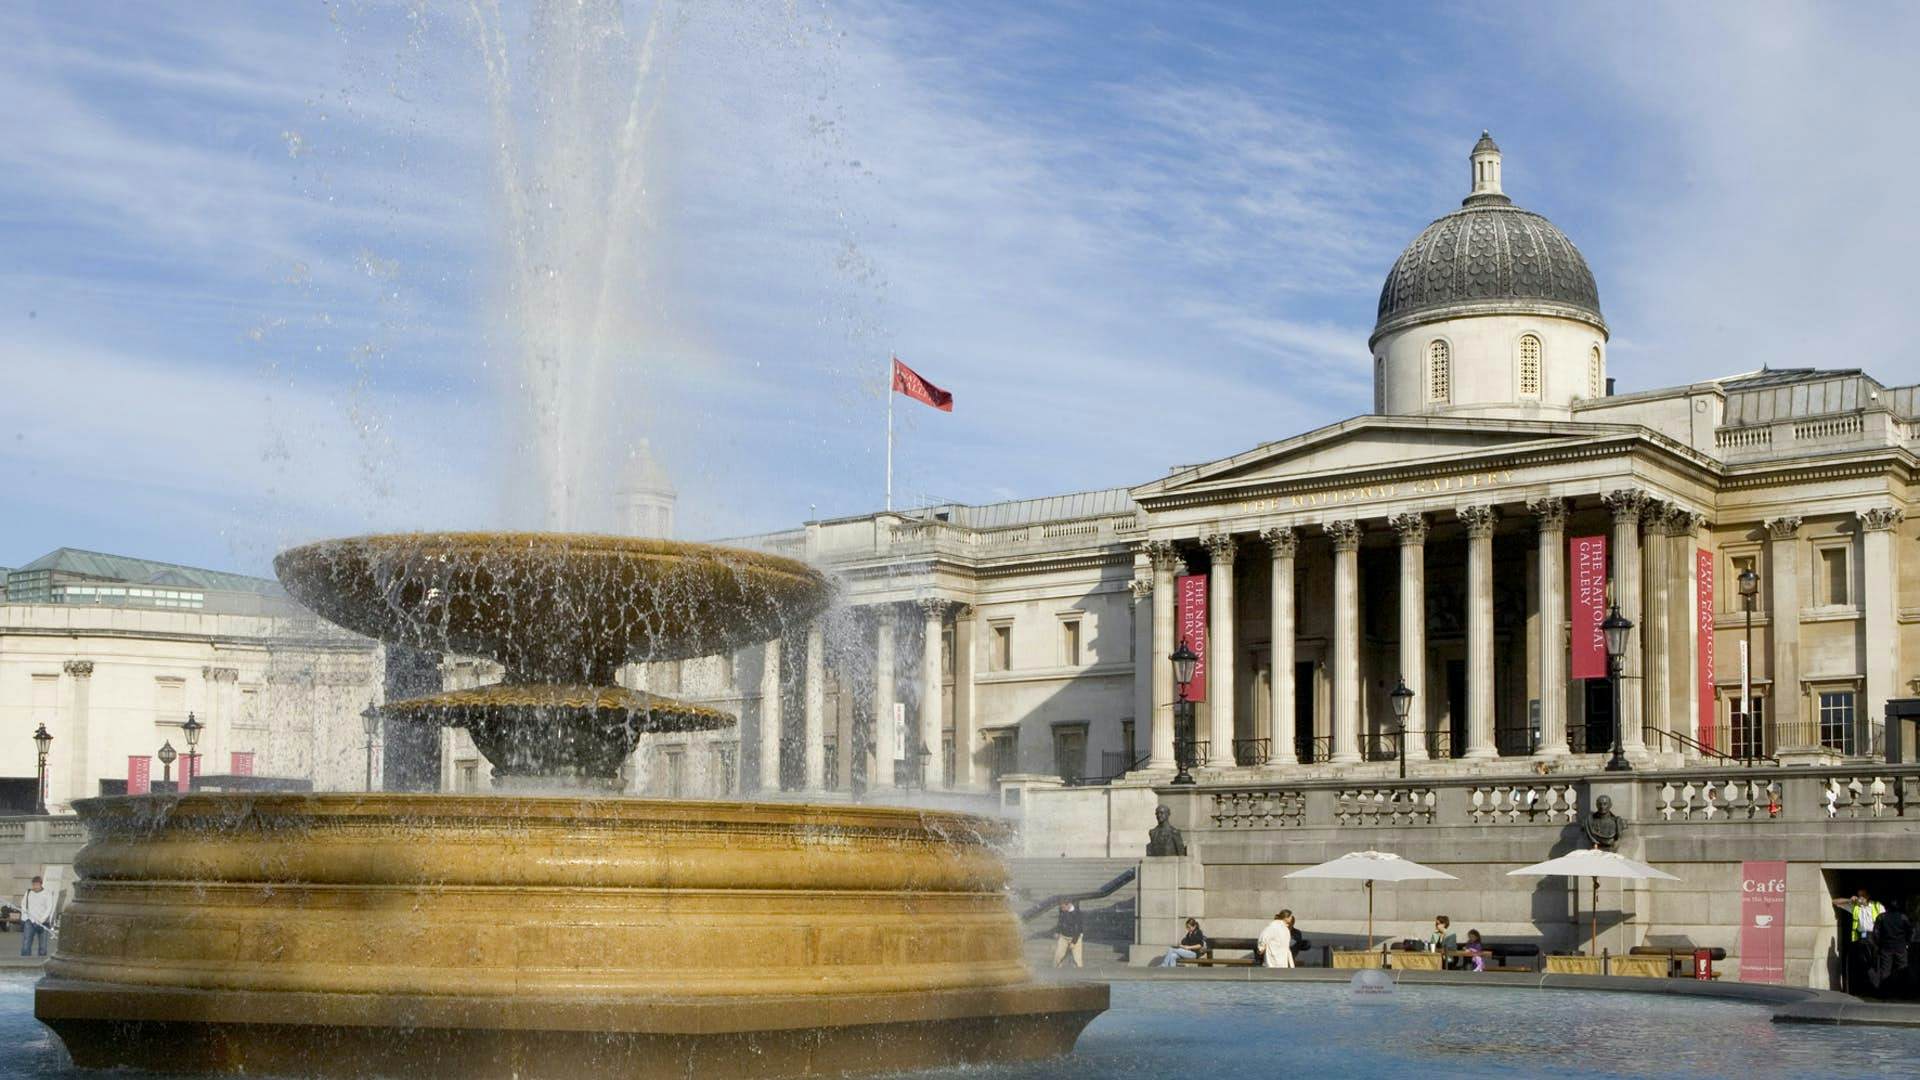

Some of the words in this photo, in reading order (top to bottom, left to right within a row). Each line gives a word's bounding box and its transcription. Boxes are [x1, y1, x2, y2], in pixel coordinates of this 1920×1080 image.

[1240, 497, 1278, 513] THE
[1291, 486, 1395, 507] NATIONAL
[1414, 470, 1513, 492] GALLERY
[1580, 542, 1591, 606] GALLERY
[1592, 540, 1603, 570] THE
[1185, 580, 1195, 637] GALLERY
[1195, 579, 1205, 606] THE
[1592, 575, 1603, 652] NATIONAL
[1700, 556, 1708, 632] GALLERY
[1195, 610, 1205, 678] NATIONAL
[1742, 879, 1785, 892] Café
